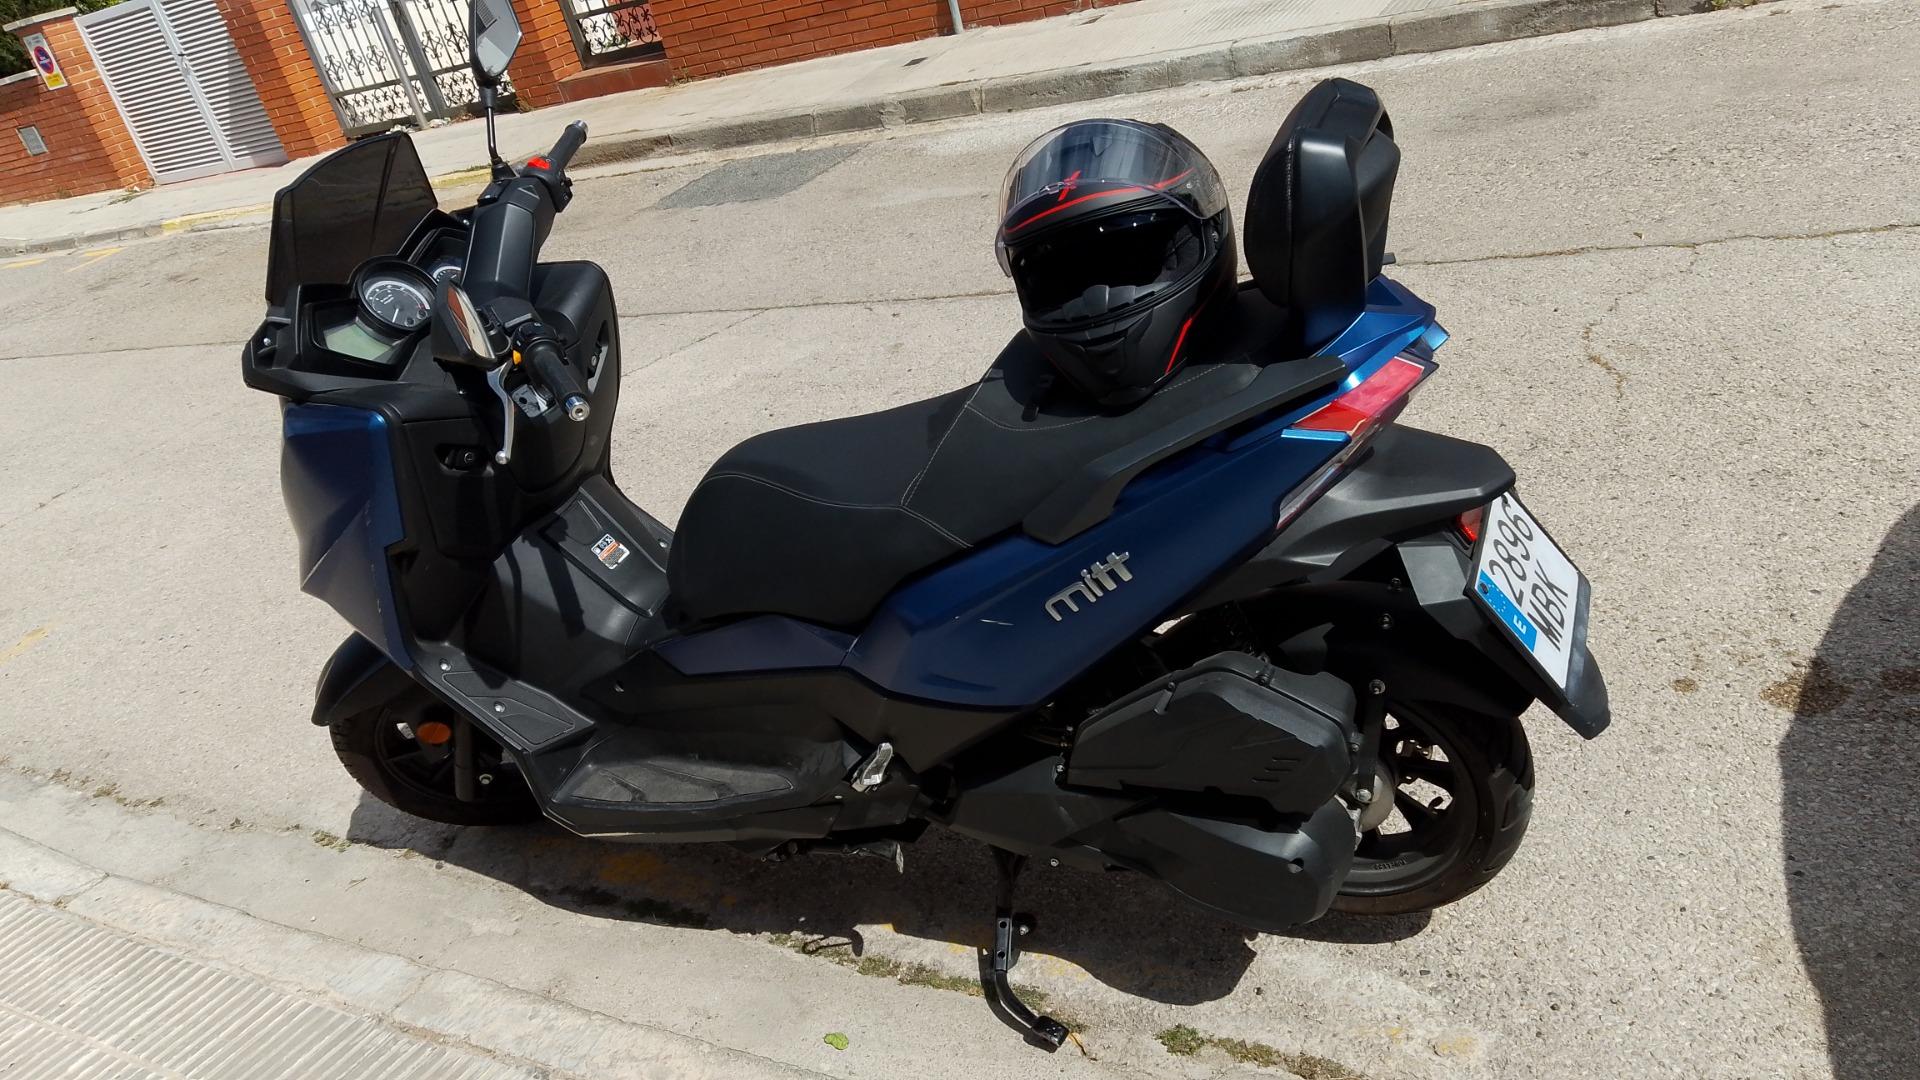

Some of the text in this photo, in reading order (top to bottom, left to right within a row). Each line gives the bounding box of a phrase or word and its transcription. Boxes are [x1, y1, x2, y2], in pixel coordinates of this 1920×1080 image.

[1044, 551, 1133, 622] mitt
[1488, 496, 1534, 608] 2896
[1513, 615, 1527, 635] E
[1526, 559, 1569, 652] MBK
